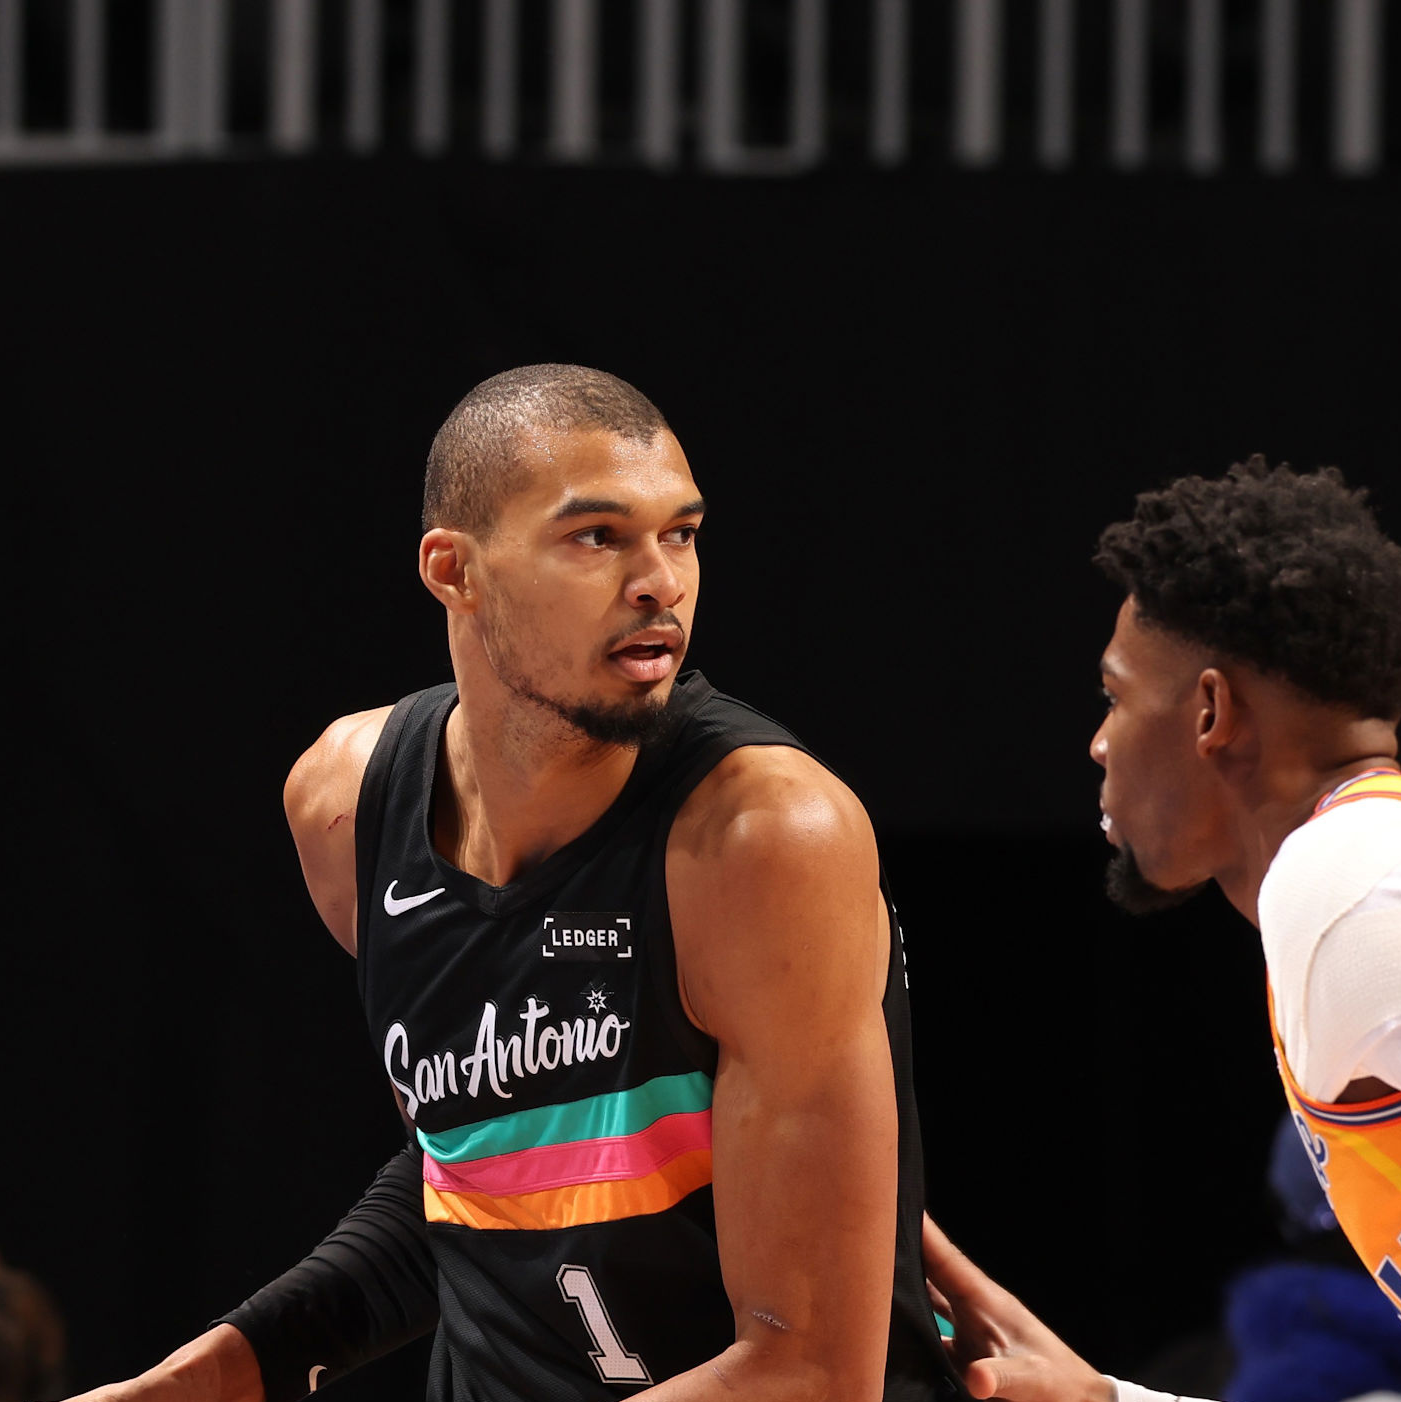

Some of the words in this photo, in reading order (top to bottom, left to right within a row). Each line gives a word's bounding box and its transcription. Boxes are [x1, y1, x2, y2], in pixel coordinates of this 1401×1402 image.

[551, 928, 618, 947] LEDGER
[383, 1021, 459, 1121] San
[460, 996, 631, 1099] Antonio
[555, 1263, 654, 1385] 1
